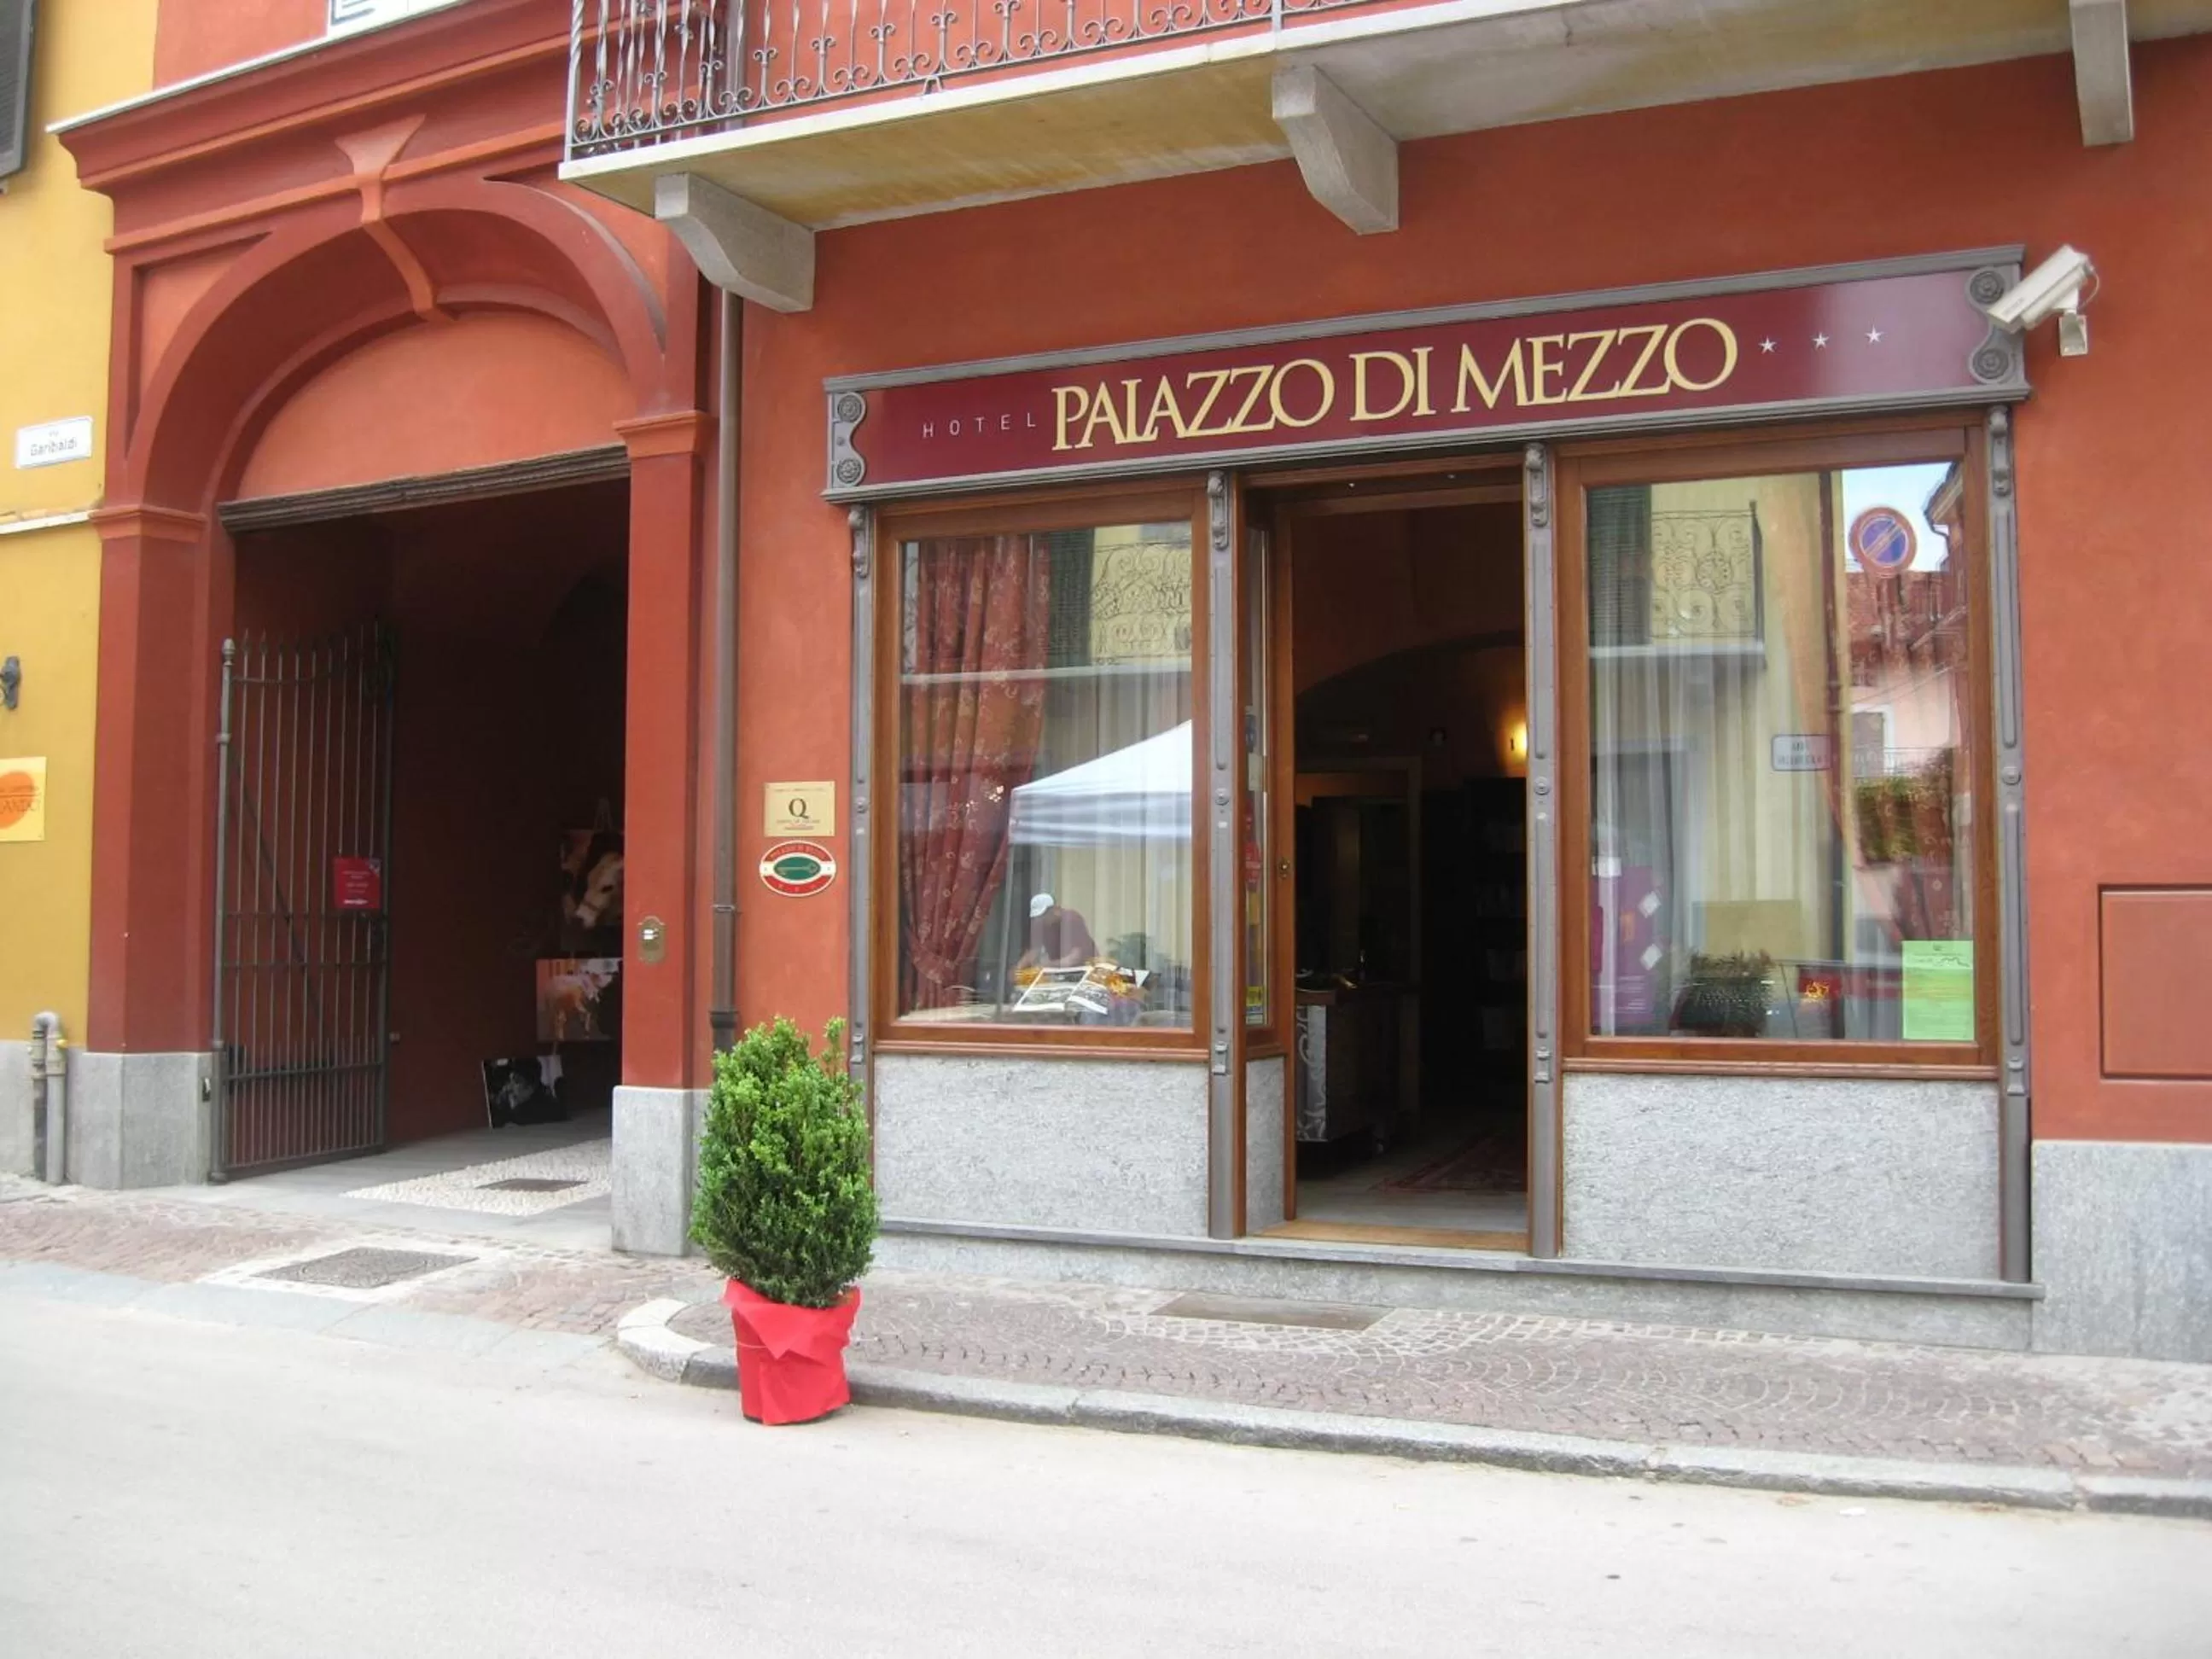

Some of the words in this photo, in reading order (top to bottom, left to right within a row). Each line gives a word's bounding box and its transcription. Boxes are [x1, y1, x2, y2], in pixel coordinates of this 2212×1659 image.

[922, 411, 1037, 439] HOTEL
[1051, 358, 1336, 451] PALAZZO
[1349, 346, 1436, 422] DI
[1450, 317, 1738, 414] MEZZO
[30, 436, 78, 457] Garibaldi
[789, 797, 809, 819] Q
